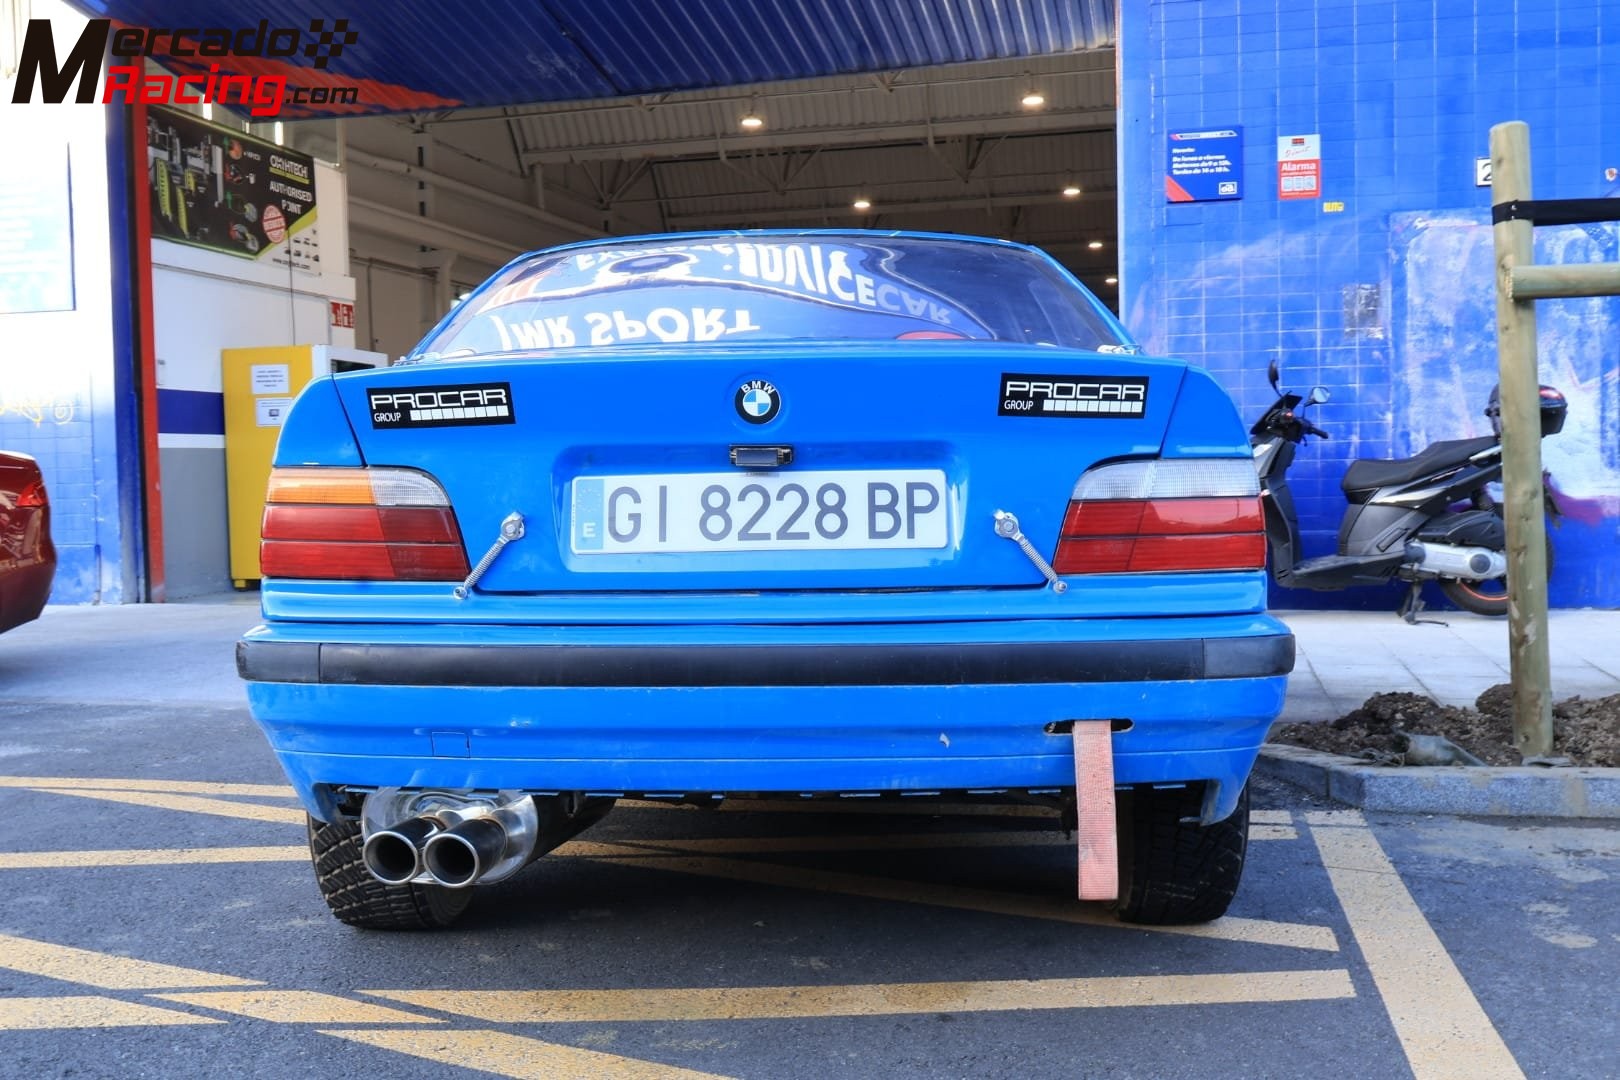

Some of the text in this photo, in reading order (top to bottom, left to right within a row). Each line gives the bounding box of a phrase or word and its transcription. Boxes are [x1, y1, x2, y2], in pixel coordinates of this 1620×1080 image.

[1281, 162, 1317, 171] Alarma
[741, 380, 775, 395] BMW
[1005, 381, 1145, 400] PROCAR
[370, 388, 507, 410] PROCAR
[1004, 399, 1034, 411] GROUP
[373, 412, 401, 423] GROUP
[607, 485, 668, 543] GI
[698, 482, 849, 542] 8228
[867, 482, 940, 540] BP
[582, 522, 597, 538] E
